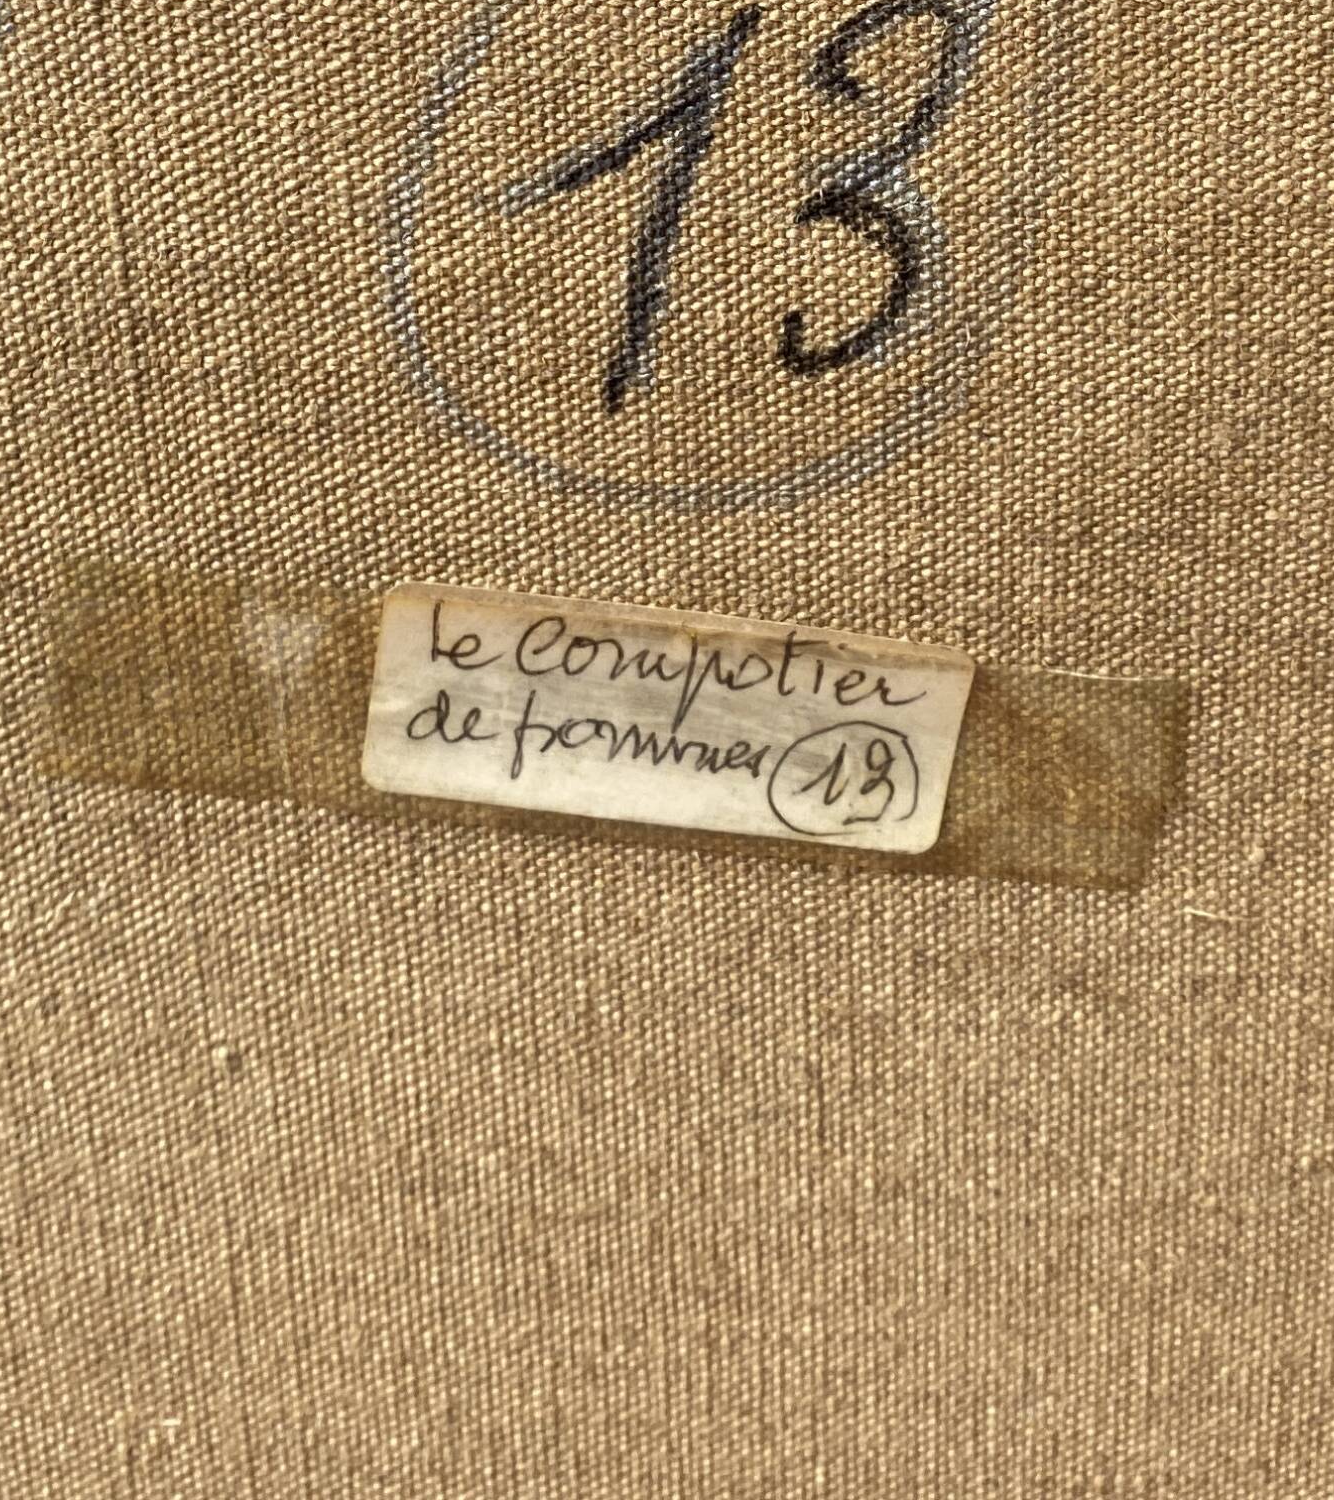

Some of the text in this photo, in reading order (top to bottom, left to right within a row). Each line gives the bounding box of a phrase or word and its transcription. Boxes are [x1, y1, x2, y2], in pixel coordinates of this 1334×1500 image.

[431, 600, 927, 733] Le Compotier
[407, 690, 497, 743] de
